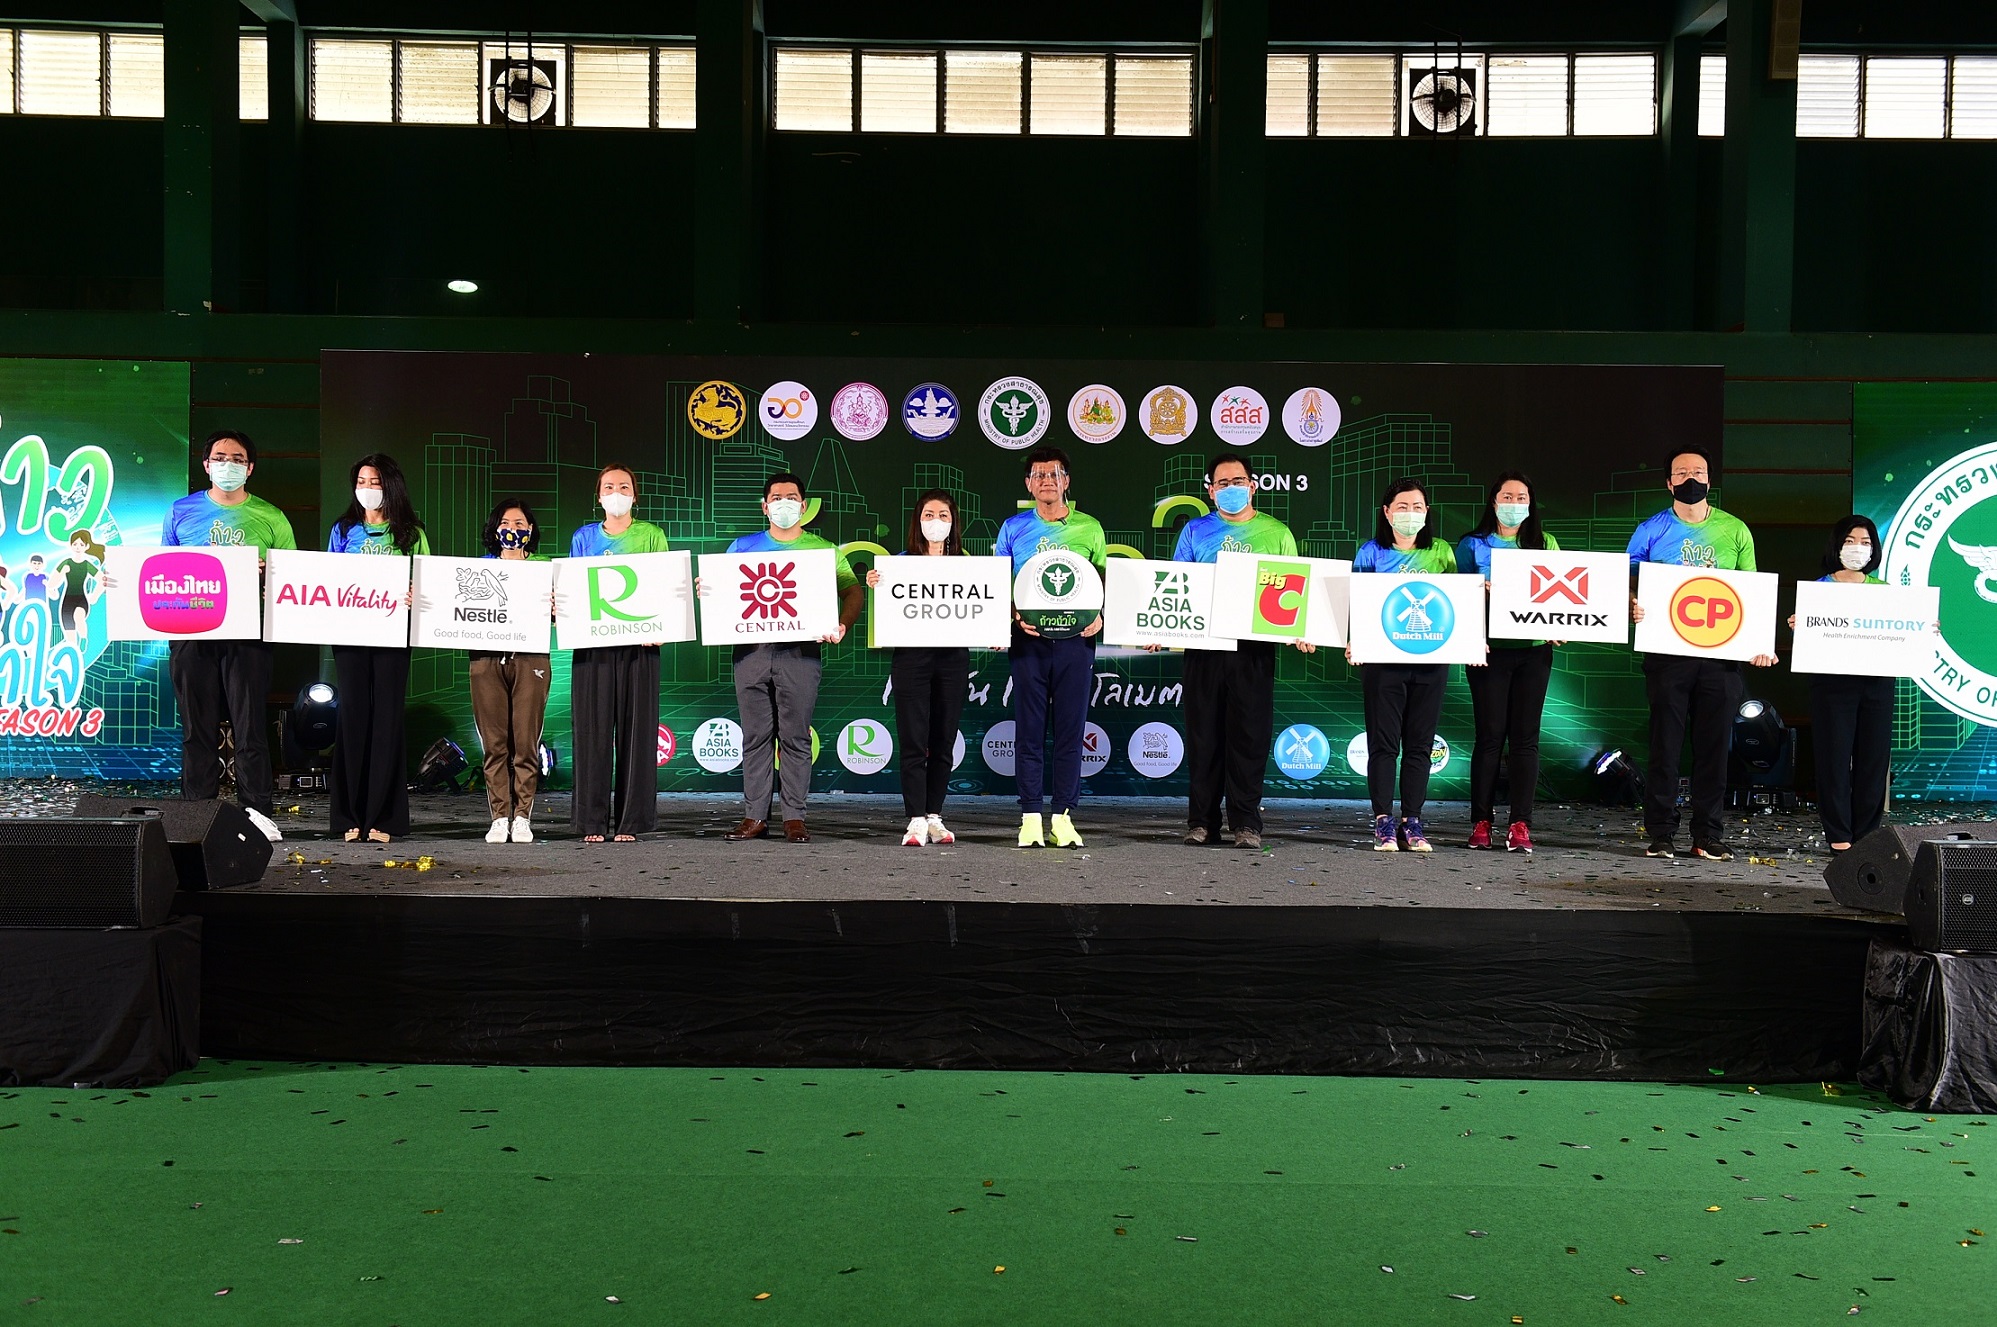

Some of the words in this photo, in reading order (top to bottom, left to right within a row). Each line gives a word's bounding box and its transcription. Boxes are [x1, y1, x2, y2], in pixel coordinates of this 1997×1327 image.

[1220, 406, 1263, 424] สสส
[984, 418, 1001, 440] MINISTRY
[1010, 436, 1031, 446] PUBLIC
[1030, 419, 1045, 438] HEALTH
[1296, 475, 1309, 491] 3
[1905, 463, 1997, 549] กระทรว
[210, 520, 245, 544] ก้าว
[145, 573, 221, 594] เมืองไทย
[1259, 571, 1288, 590] Big
[587, 565, 660, 621] R
[891, 583, 994, 600] CENTRAL
[276, 583, 331, 607] AIA
[337, 583, 397, 617] Vitality
[1148, 596, 1192, 613] ASIA
[1259, 574, 1308, 627] C
[903, 603, 983, 619] GROUP
[1509, 610, 1609, 627] WARRIX
[1677, 595, 1734, 629] CP
[590, 621, 662, 636] ROBINSON
[735, 620, 806, 633] CENTRAL
[1136, 612, 1205, 631] BOOKS
[1806, 616, 1849, 628] BRANDS
[434, 628, 459, 638] Good
[461, 629, 484, 640] food,
[486, 631, 511, 641] Good
[513, 632, 527, 641] life
[1135, 630, 1205, 638] www.asiabooks.com
[1392, 632, 1422, 640] Dutch
[1423, 632, 1444, 640] Mill
[1843, 632, 1877, 640] Enrichment
[1877, 634, 1905, 642] Company
[0, 708, 80, 735] ASON
[82, 709, 103, 735] 3
[706, 738, 731, 747] ASIA
[987, 740, 1016, 749] CENT
[699, 748, 739, 757] BOOKS
[992, 749, 1014, 758] GRO
[846, 757, 887, 765] ROBINSON
[1281, 762, 1304, 770] Dutch
[1305, 762, 1322, 770] Mill
